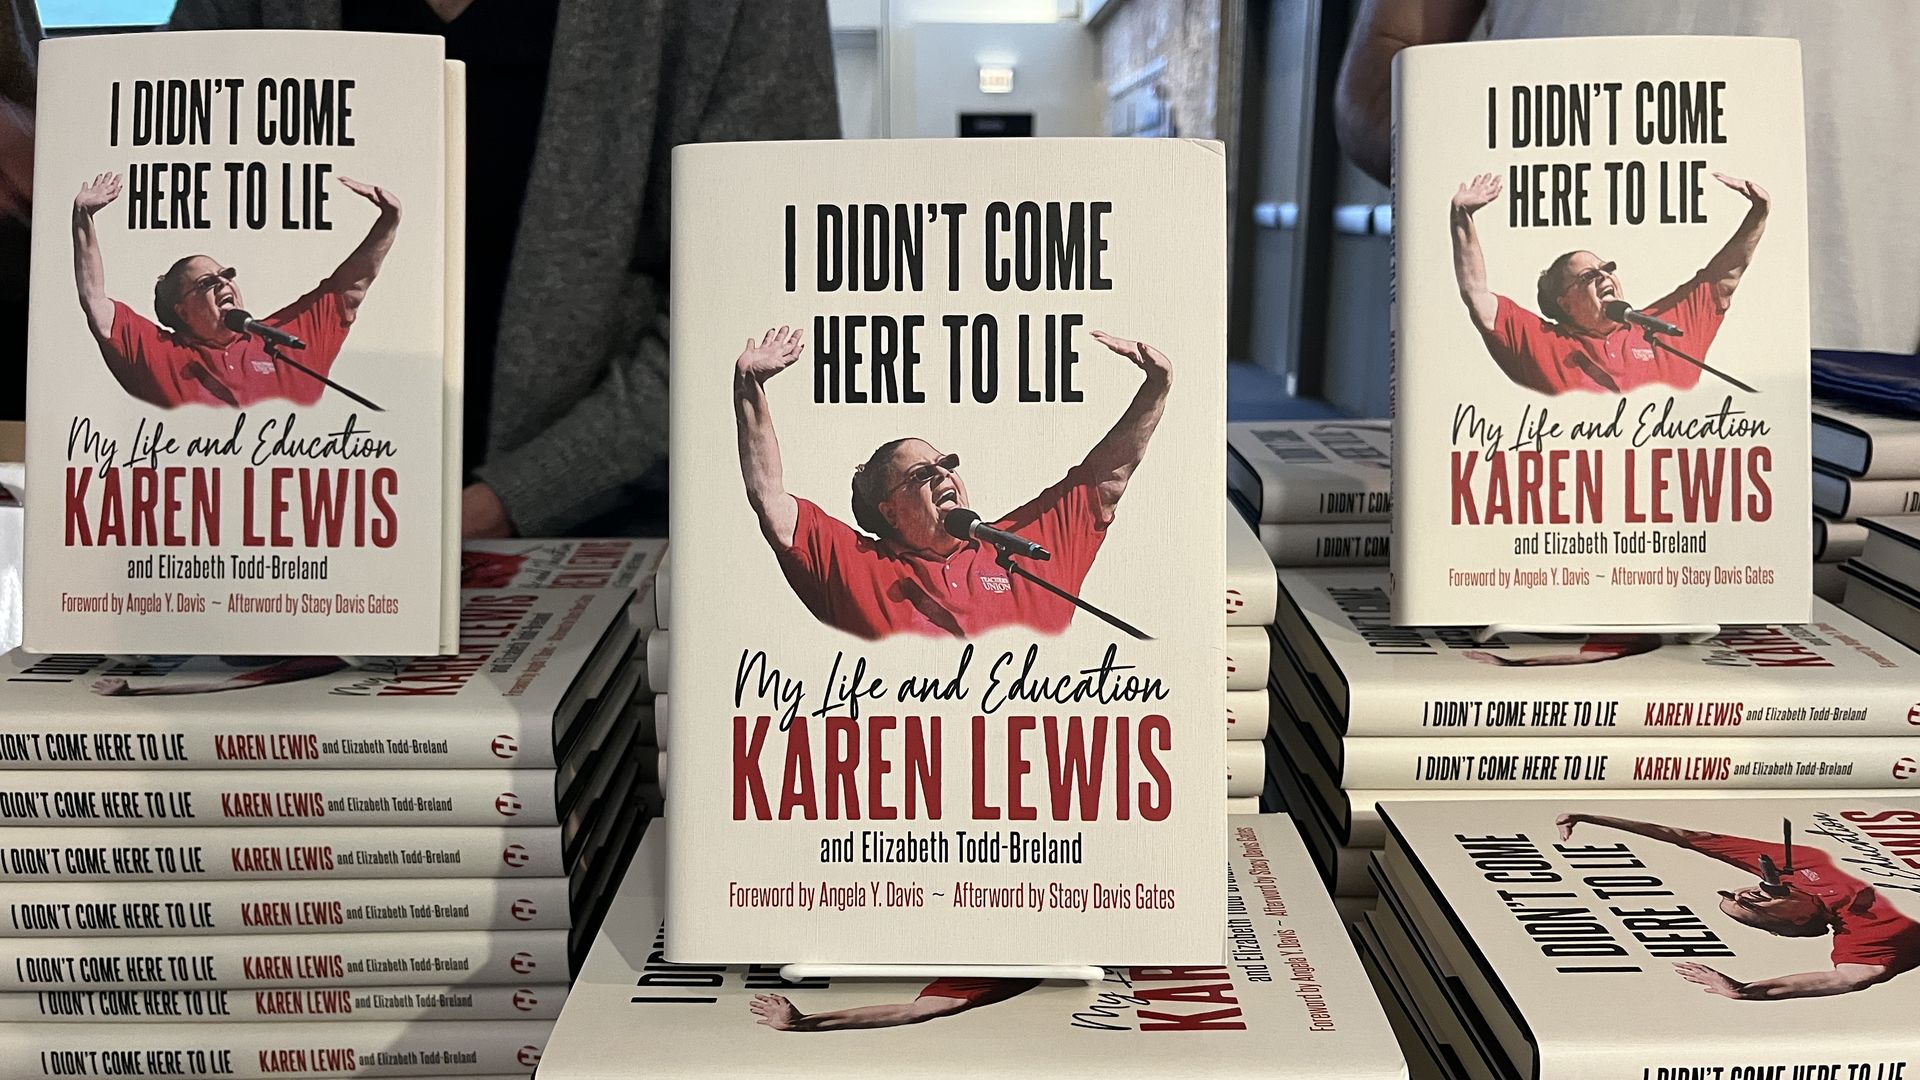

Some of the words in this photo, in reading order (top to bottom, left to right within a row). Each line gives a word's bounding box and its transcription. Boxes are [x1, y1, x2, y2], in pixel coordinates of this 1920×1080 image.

[111, 82, 120, 146] I
[133, 79, 244, 146] DIDN'T
[258, 78, 355, 146] COME
[1489, 87, 1496, 149] I
[1512, 83, 1622, 148] DIDN'T
[1636, 81, 1727, 145] COME
[128, 163, 211, 229] HERE
[224, 162, 266, 230] TO
[282, 163, 332, 230] LIE
[1510, 163, 1591, 227] HERE
[1605, 161, 1645, 225] TO
[1660, 161, 1707, 223] LIE
[785, 205, 795, 292] I
[817, 203, 967, 292] DIDN'T
[986, 201, 1112, 291] COME
[814, 315, 925, 403] HERE
[942, 314, 998, 404] TO
[1019, 314, 1083, 402] LIE
[67, 415, 118, 478] My
[123, 417, 180, 470] Life
[187, 412, 246, 456] and
[251, 413, 398, 467] Education
[1452, 403, 1504, 462] My
[1508, 403, 1564, 453] Life
[1570, 397, 1627, 441] and
[1632, 396, 1771, 448] Education
[1450, 449, 1603, 526] KAREN
[1624, 446, 1772, 524] LEWIS
[64, 467, 221, 547] KAREN
[243, 467, 399, 548] LEWIS
[1364, 537, 1390, 557] COM
[1515, 532, 1538, 554] and
[1545, 532, 1607, 554] Elizabeth
[1613, 530, 1706, 553] Todd-Breland
[128, 555, 152, 578] and
[159, 555, 224, 579] Elizabeth
[231, 555, 327, 579] Todd-Breland
[1449, 568, 1495, 586] Foreword
[1499, 568, 1510, 589] by
[1514, 568, 1547, 589] Angela
[1551, 568, 1559, 585] Y.
[1563, 568, 1589, 585] Davis
[1612, 566, 1663, 585] Afterword
[1667, 566, 1678, 587] by
[1682, 566, 1711, 587] Stacy
[1715, 566, 1742, 584] Davis
[1746, 566, 1774, 584] Gates
[62, 593, 108, 612] Foreword
[112, 593, 123, 615] by
[127, 593, 161, 615] Angela
[165, 593, 173, 612] Y.
[177, 593, 205, 612] Davis
[228, 593, 282, 613] Afterword
[286, 594, 298, 616] by
[302, 594, 332, 616] Stacy
[336, 594, 364, 614] Davis
[368, 594, 398, 614] Gates
[735, 648, 806, 732] My
[812, 651, 888, 720] Life
[898, 643, 974, 702] and
[981, 643, 1170, 714] Education
[1423, 702, 1428, 726] I
[1433, 702, 1482, 727] DIDN'T
[1486, 701, 1527, 727] COME
[1531, 702, 1569, 726] HERE
[1574, 702, 1591, 726] TO
[1595, 702, 1618, 726] LIE
[1644, 703, 1693, 726] KAREN
[1696, 703, 1743, 726] LEWIS
[1746, 707, 1763, 720] and
[1765, 707, 1806, 721] Elizabeth
[1809, 707, 1867, 721] Todd-Breland
[732, 716, 942, 821] KAREN
[971, 714, 1172, 822] LEWIS
[1416, 756, 1421, 780] I
[1425, 756, 1474, 780] DIDN'T
[1478, 756, 1519, 780] COME
[1522, 756, 1559, 780] HERE
[1564, 756, 1581, 780] TO
[1585, 756, 1608, 780] LIE
[1633, 757, 1681, 780] KAREN
[1685, 757, 1731, 780] LEWIS
[1734, 762, 1750, 775] and
[1752, 762, 1793, 775] Elizabeth
[1796, 762, 1853, 775] Todd-Breland
[54, 792, 100, 818] COME
[102, 792, 144, 818] HERE
[144, 792, 166, 818] TO
[169, 792, 195, 818] LIE
[222, 793, 274, 818] KAREN
[276, 793, 325, 817] LEWIS
[328, 797, 345, 811] and
[347, 797, 390, 812] Elizabeth
[392, 797, 452, 811] Todd-Breland
[821, 831, 853, 862] and
[863, 831, 948, 863] Elizabeth
[956, 831, 1081, 864] Todd-Breland
[1455, 834, 1563, 883] COME
[1553, 843, 1647, 868] LIE
[730, 882, 793, 907] Foreword
[799, 882, 815, 911] by
[819, 882, 865, 911] Angela
[871, 882, 881, 907] Y.
[887, 882, 923, 907] Davis
[954, 882, 1023, 908] Afterword
[1029, 883, 1045, 912] by
[1050, 883, 1088, 912] Stacy
[1094, 883, 1130, 909] Davis
[1136, 883, 1174, 909] Gates
[1583, 875, 1675, 900] TO
[11, 905, 19, 929] I
[21, 904, 72, 930] DIDN'T
[76, 904, 120, 929] COME
[123, 903, 163, 929] HERE
[165, 903, 186, 928] TO
[190, 903, 215, 928] LIE
[242, 903, 292, 926] KAREN
[295, 901, 343, 925] LEWIS
[346, 906, 363, 919] and
[366, 905, 407, 919] Elizabeth
[410, 905, 469, 918] Todd-Breland
[1497, 890, 1629, 957] DIDN'T
[1608, 906, 1737, 958] HERE
[17, 958, 24, 982] I
[26, 958, 76, 983] DIDN'T
[80, 957, 124, 983] COME
[126, 957, 166, 982] HERE
[168, 957, 189, 981] TO
[192, 956, 217, 981] LIE
[243, 956, 294, 980] KAREN
[297, 955, 344, 979] LEWIS
[347, 960, 364, 973] and
[366, 959, 408, 972] Elizabeth
[410, 958, 469, 972] Todd-Breland
[1555, 966, 1643, 974] I
